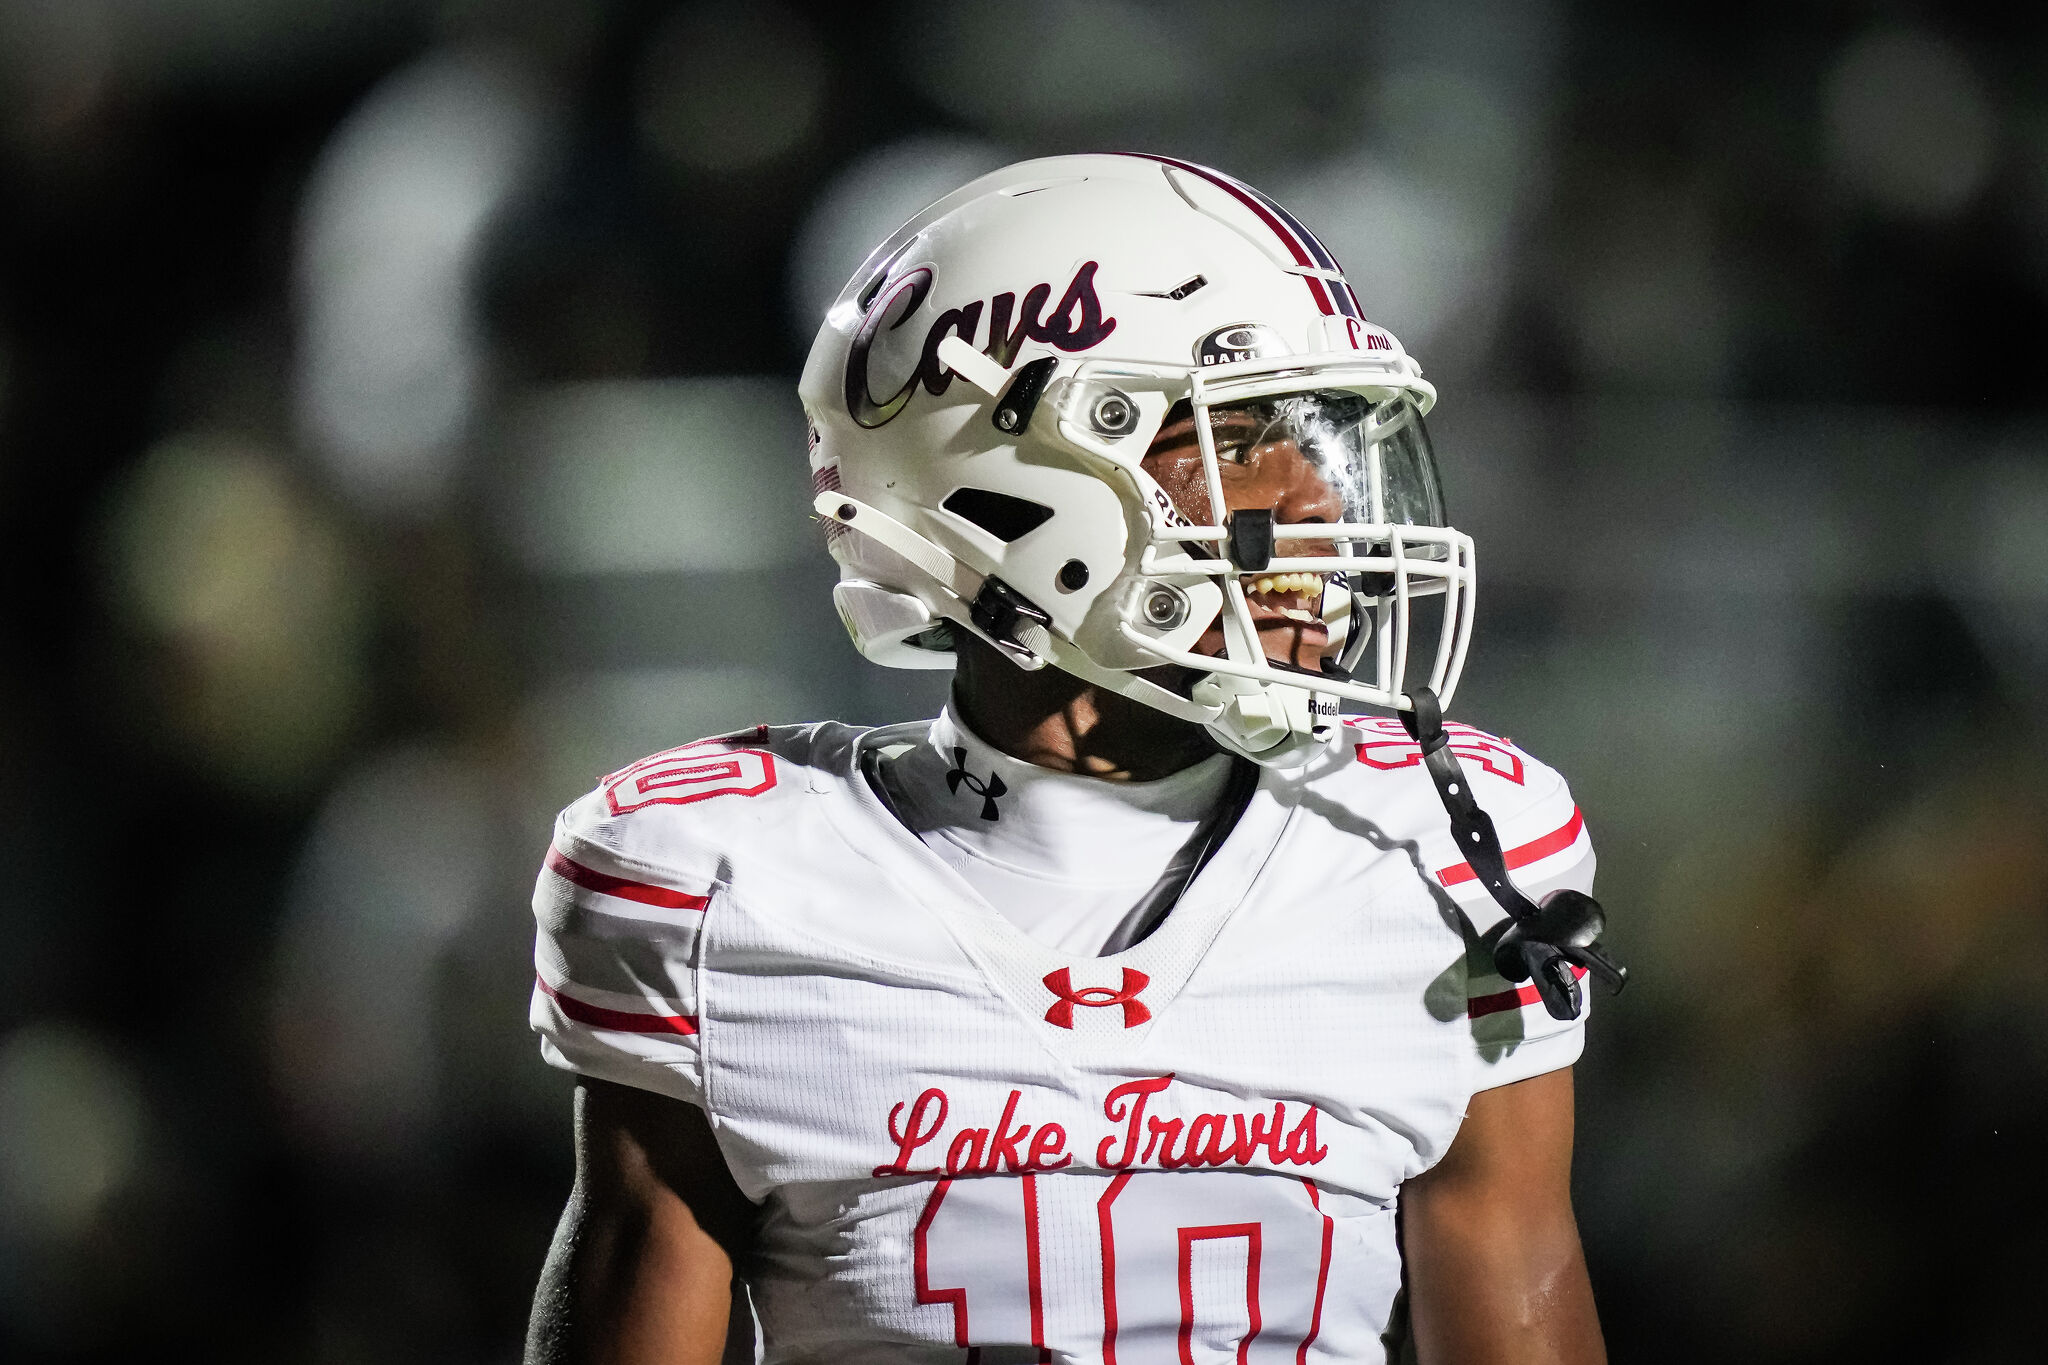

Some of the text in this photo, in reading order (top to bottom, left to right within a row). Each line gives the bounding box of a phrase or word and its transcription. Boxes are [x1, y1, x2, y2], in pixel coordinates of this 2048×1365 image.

[845, 261, 1117, 430] Cavs
[872, 1072, 1328, 1179] Lake Travis
[914, 1172, 1334, 1365] 10
